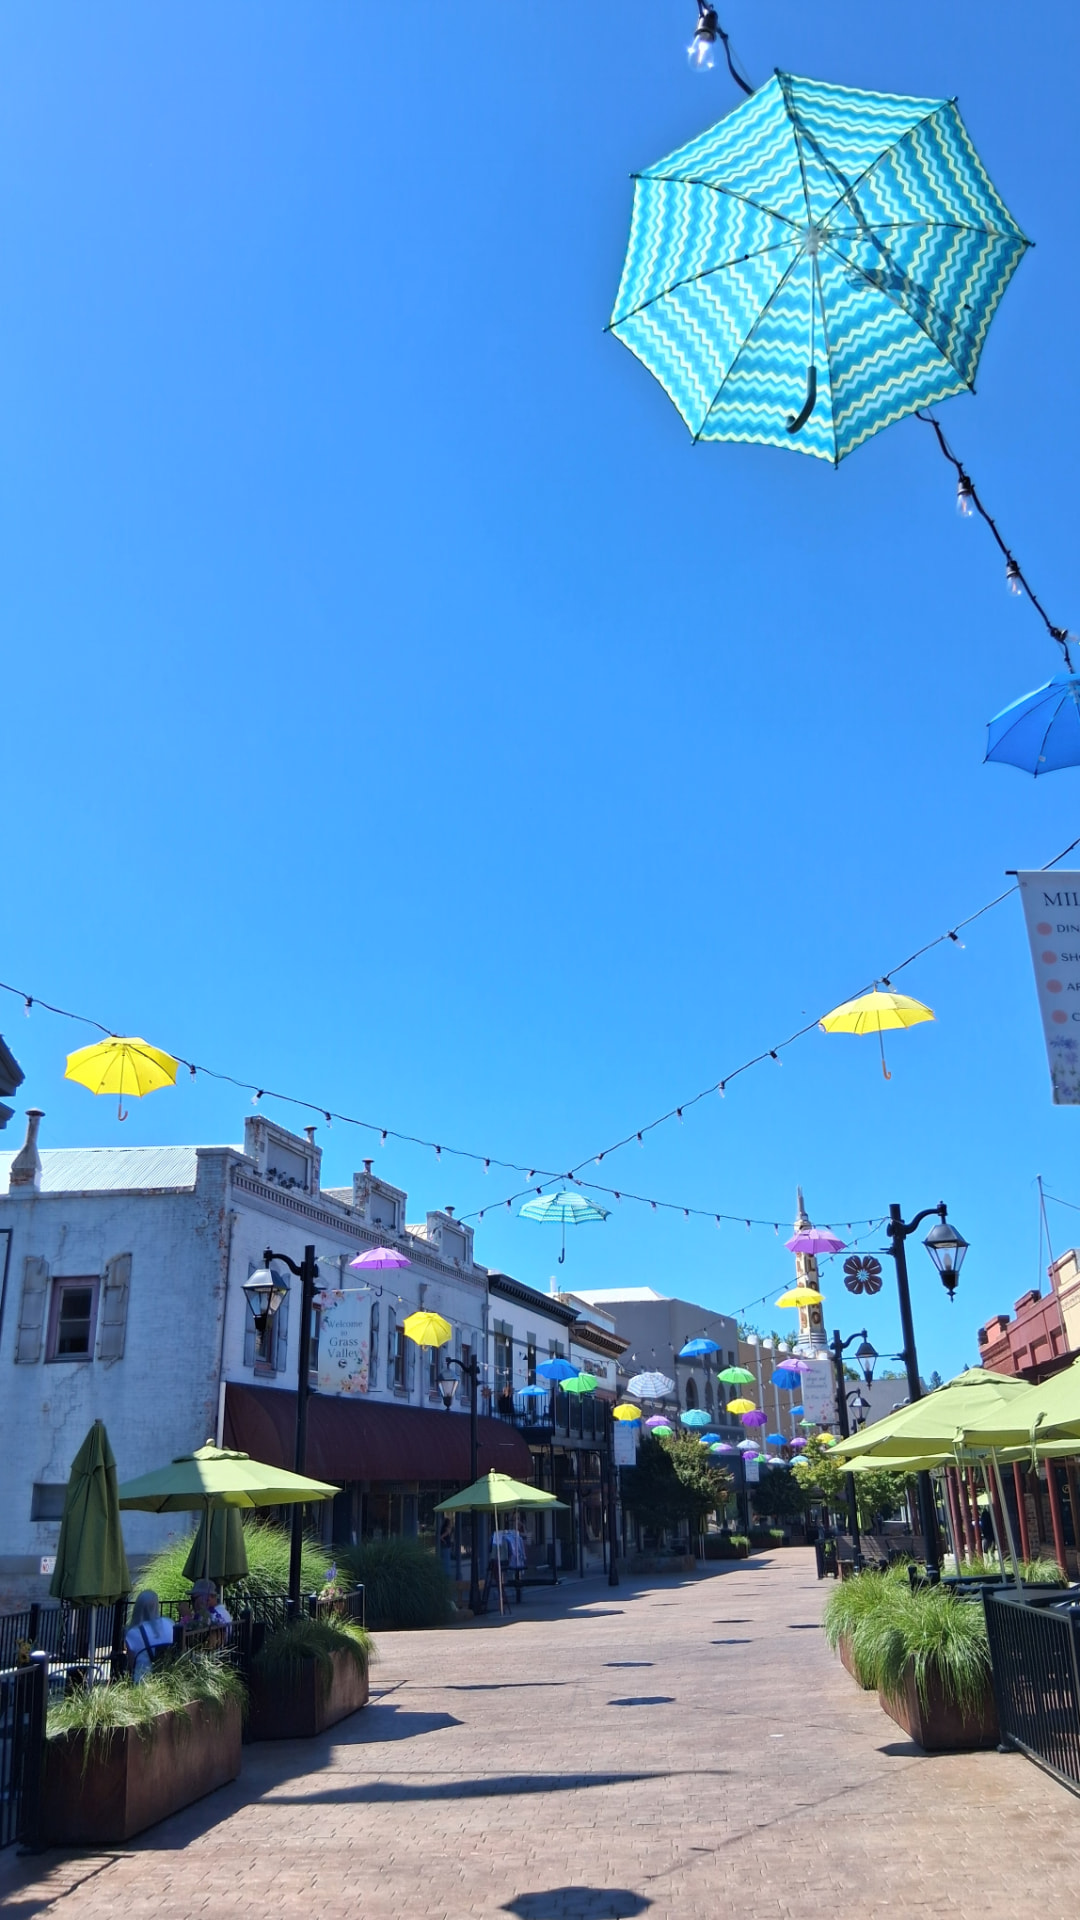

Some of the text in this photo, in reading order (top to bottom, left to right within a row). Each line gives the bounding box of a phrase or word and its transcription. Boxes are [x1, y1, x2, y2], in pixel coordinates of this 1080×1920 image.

[1061, 953, 1080, 962] SH
[327, 1319, 363, 1329] Welcome
[329, 1336, 359, 1347] Grass
[327, 1348, 361, 1360] Valley
